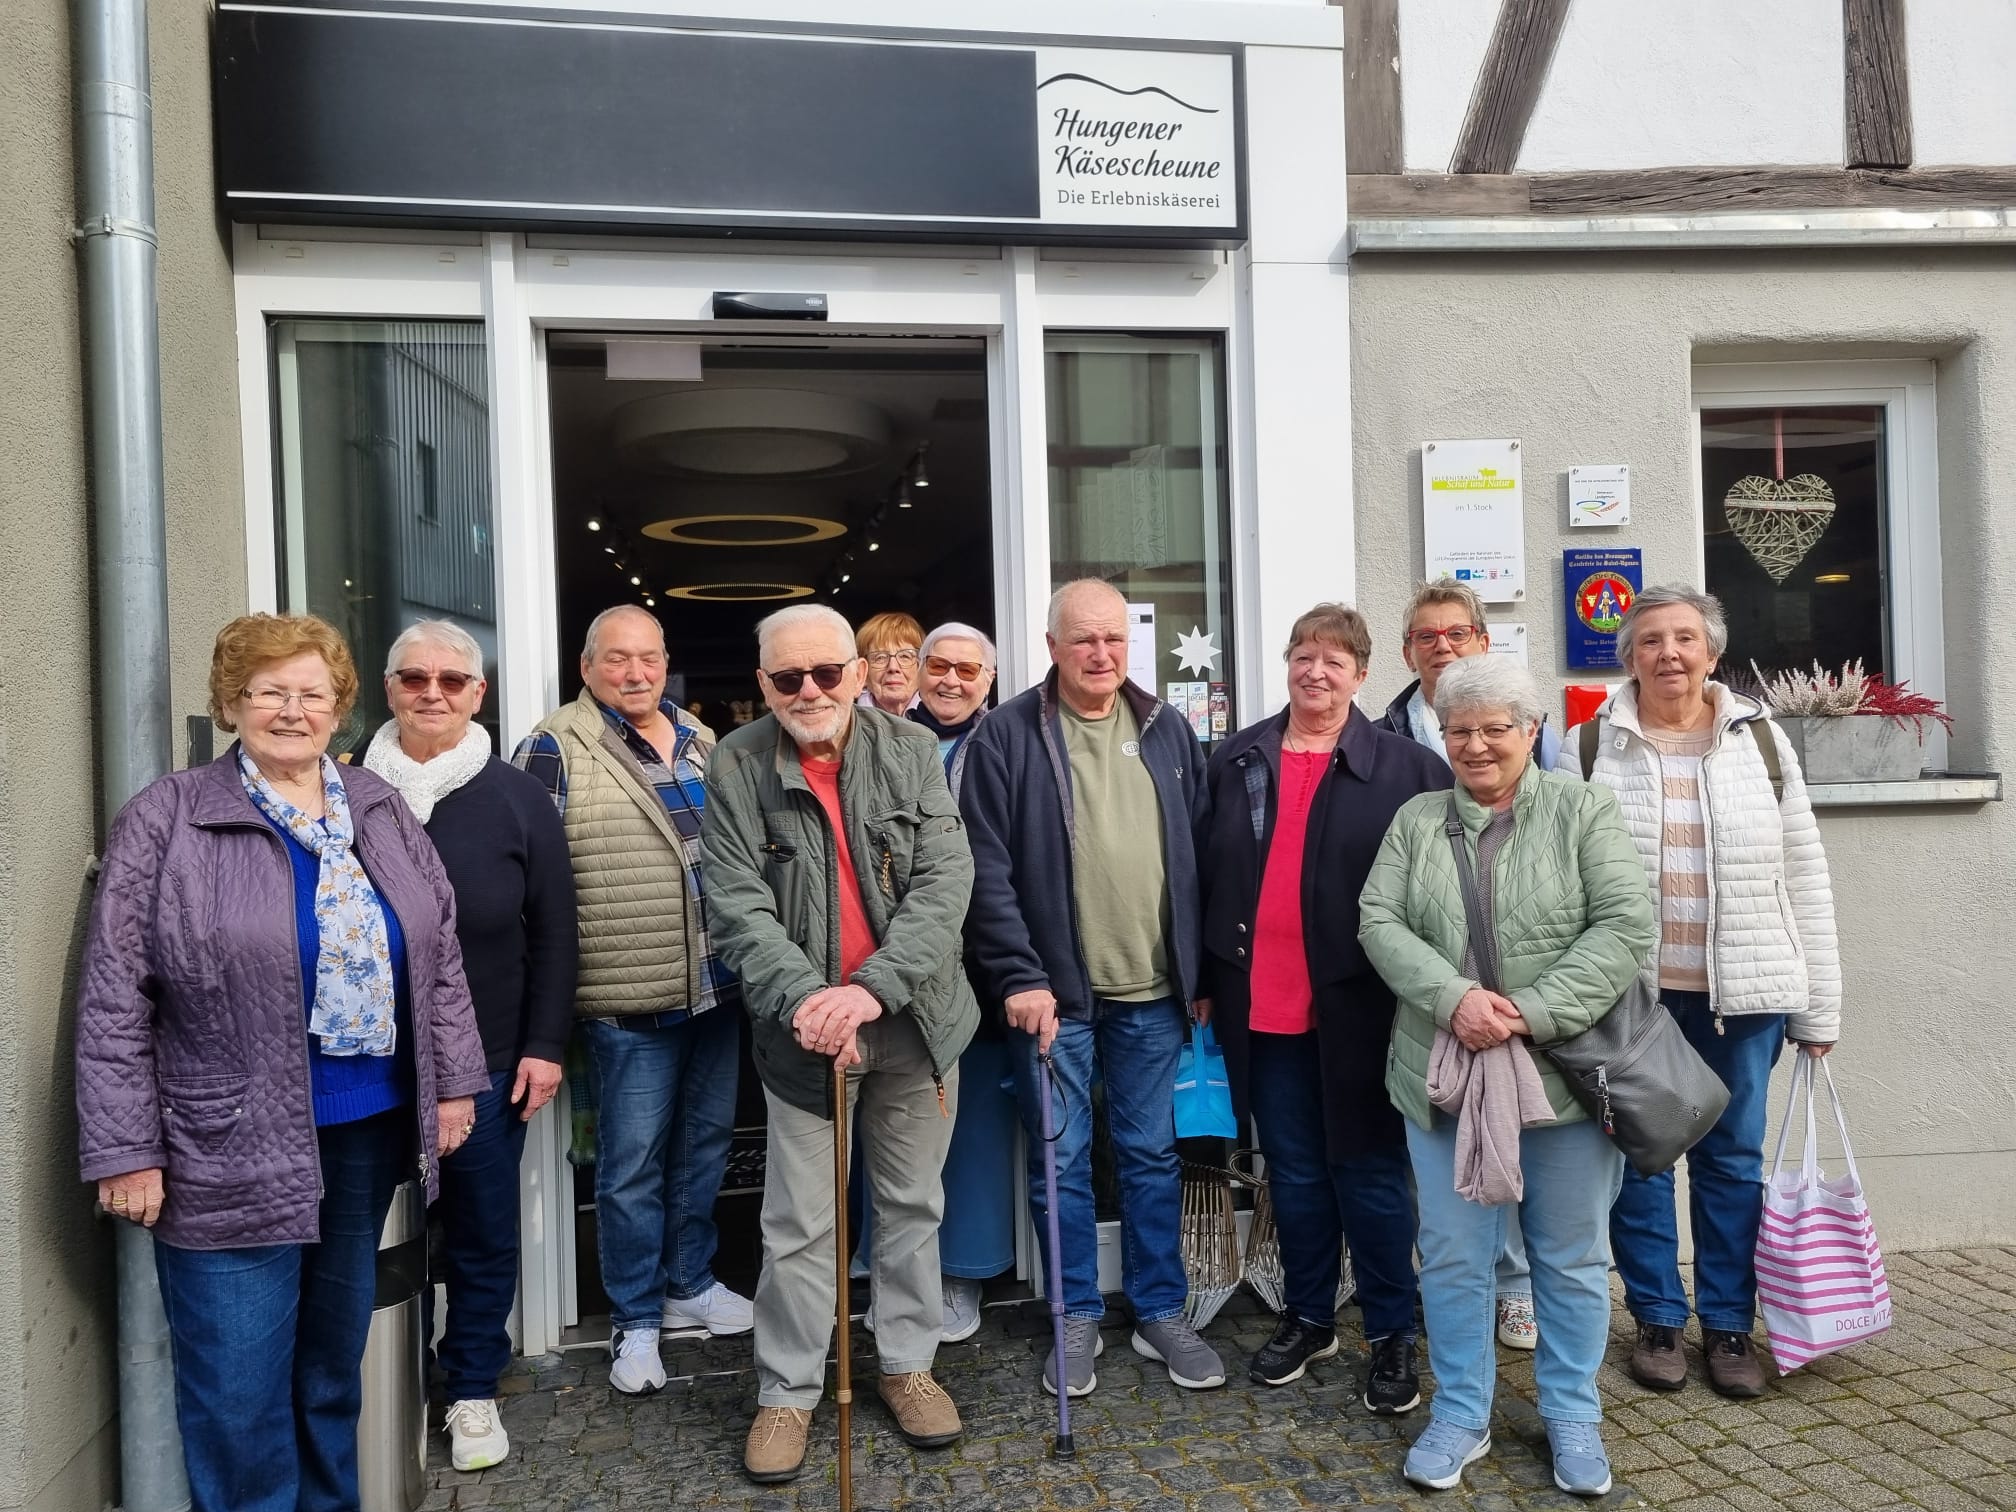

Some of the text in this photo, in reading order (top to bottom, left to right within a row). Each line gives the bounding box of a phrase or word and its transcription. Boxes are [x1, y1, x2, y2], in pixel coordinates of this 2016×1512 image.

[1054, 108, 1182, 146] Hungener
[1055, 145, 1221, 179] Käsescheune
[1058, 189, 1220, 208] Die Erlebniskäserei
[1487, 479, 1511, 488] Natur
[1473, 503, 1493, 511] Stock
[1835, 1315, 1870, 1332] DOLCE
